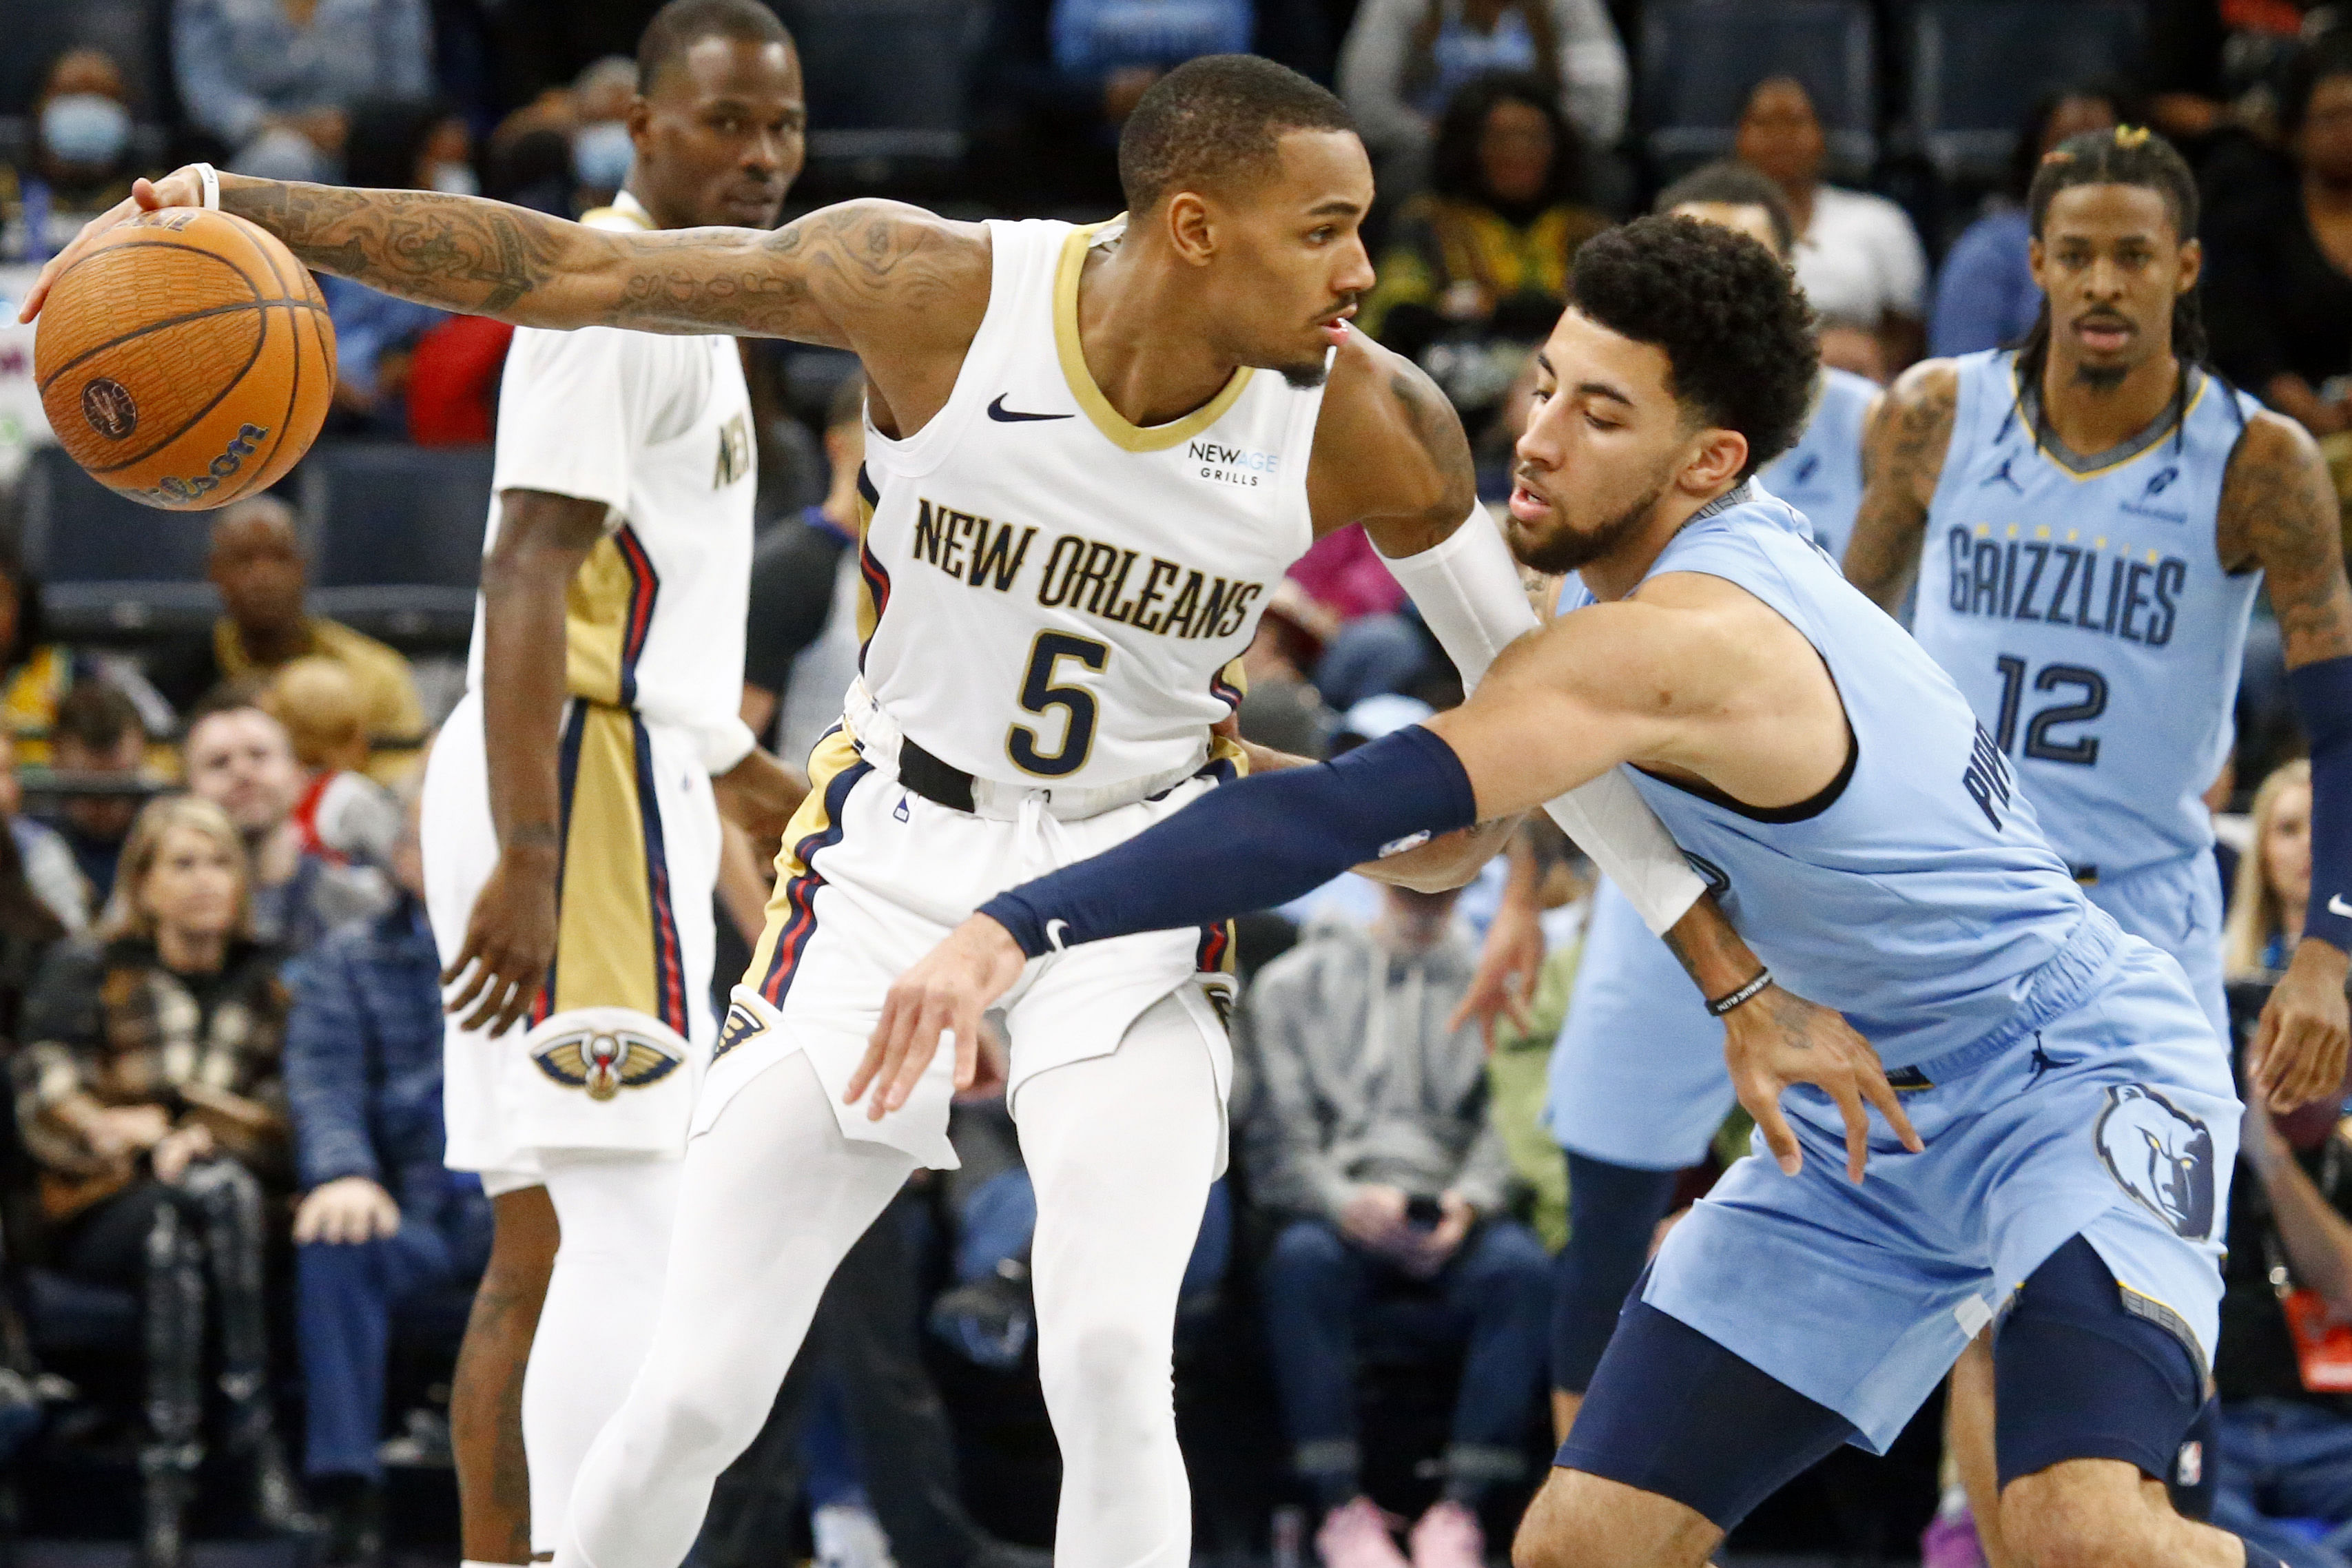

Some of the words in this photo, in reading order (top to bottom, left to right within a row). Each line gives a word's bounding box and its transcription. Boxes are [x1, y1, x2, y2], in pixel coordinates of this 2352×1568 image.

[1201, 467, 1258, 486] GRILLS
[914, 497, 1040, 593] NEW
[1038, 535, 1264, 640] ORLEANS
[1949, 524, 2187, 648] GRIZZLIES
[1004, 628, 1111, 780] 5
[1997, 651, 2109, 767] 12
